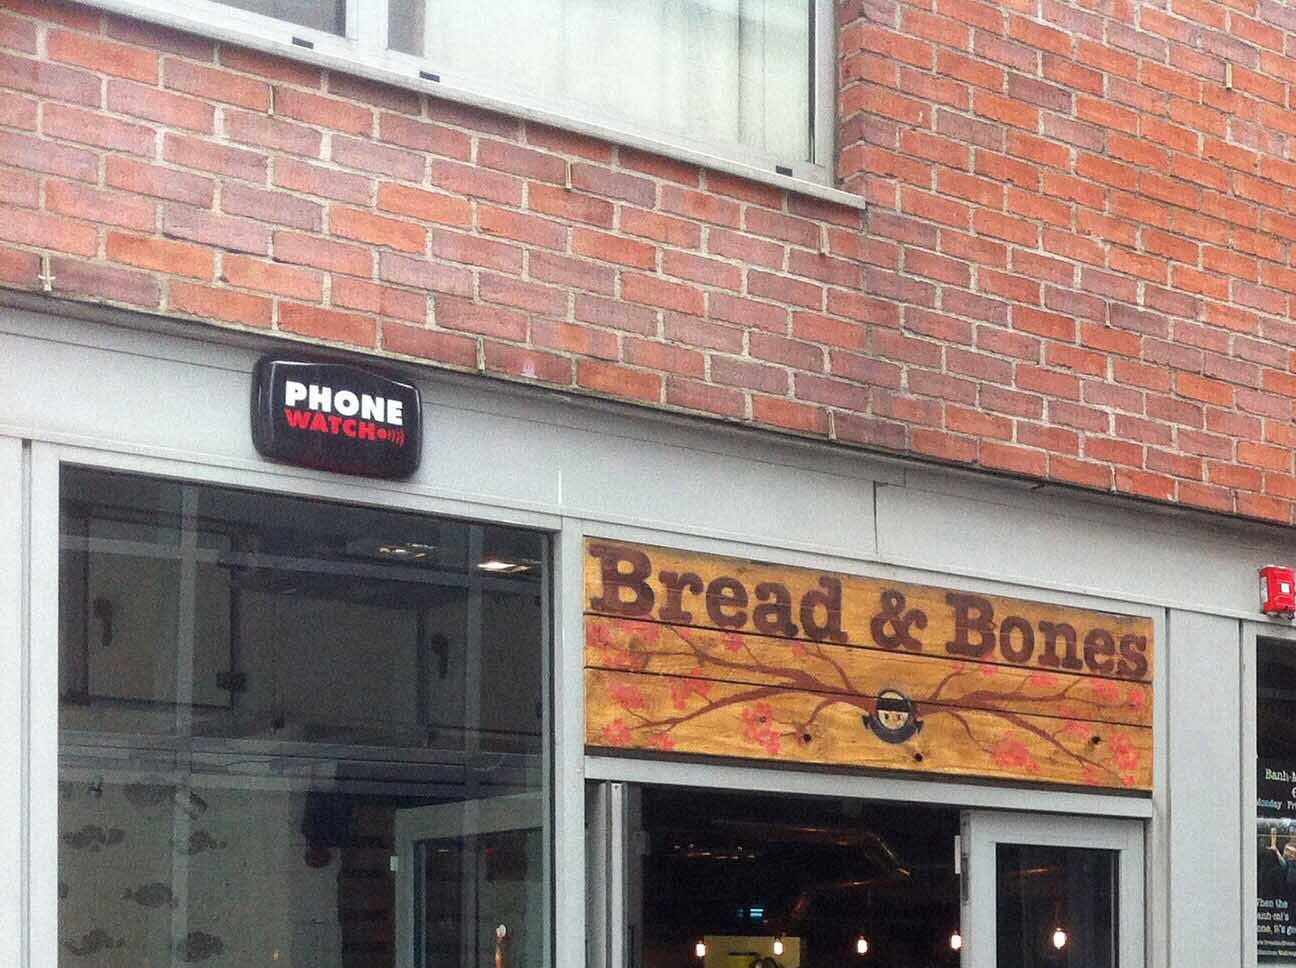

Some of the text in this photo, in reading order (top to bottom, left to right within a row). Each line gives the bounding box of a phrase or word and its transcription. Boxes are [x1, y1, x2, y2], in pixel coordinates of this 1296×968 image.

[284, 407, 376, 441] WATCH
[285, 380, 404, 426] PHONE
[588, 542, 1149, 680] Bread & Bones
